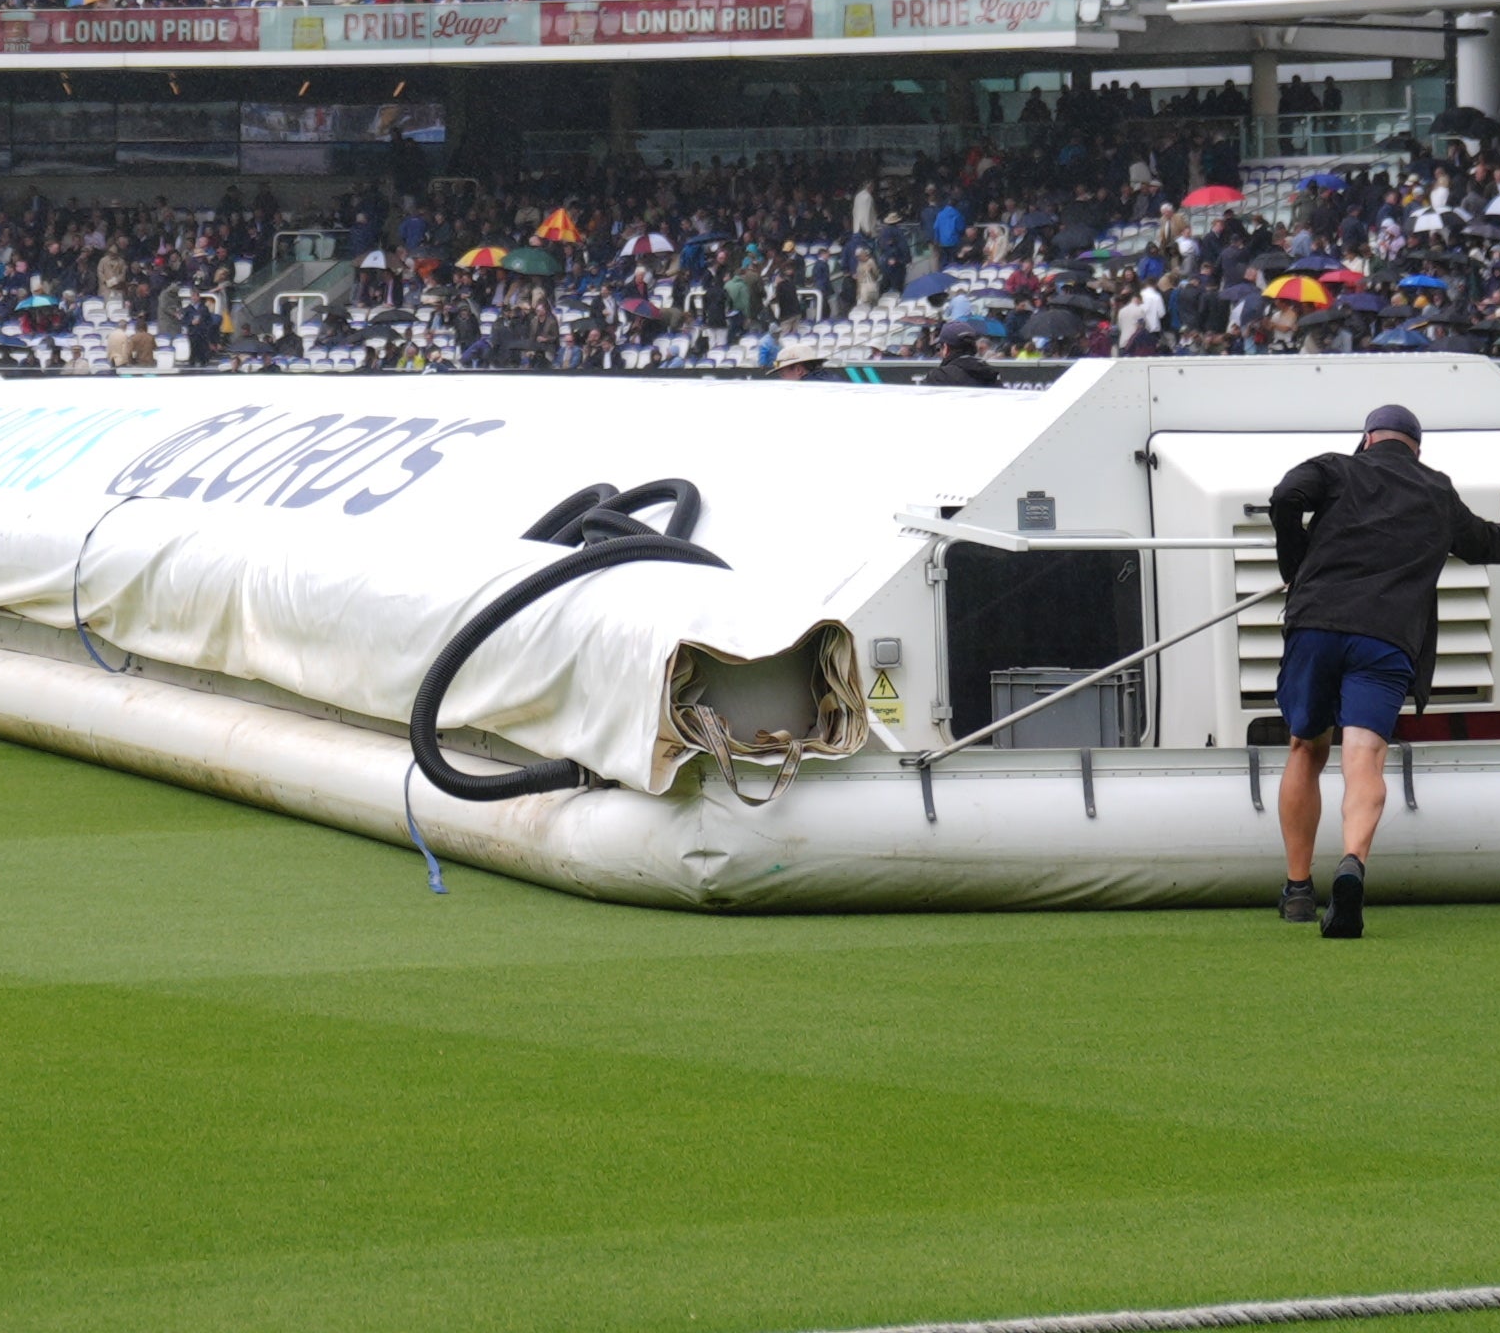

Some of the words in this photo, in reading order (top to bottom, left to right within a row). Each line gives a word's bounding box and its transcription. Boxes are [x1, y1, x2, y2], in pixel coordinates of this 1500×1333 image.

[59, 19, 155, 44] LONDON
[162, 18, 230, 43] PRIDE
[343, 12, 426, 40] PRIDE
[432, 10, 508, 45] Lager
[622, 7, 715, 33] LONDON
[721, 5, 786, 31] PRIDE
[158, 411, 507, 517] LORD'S
